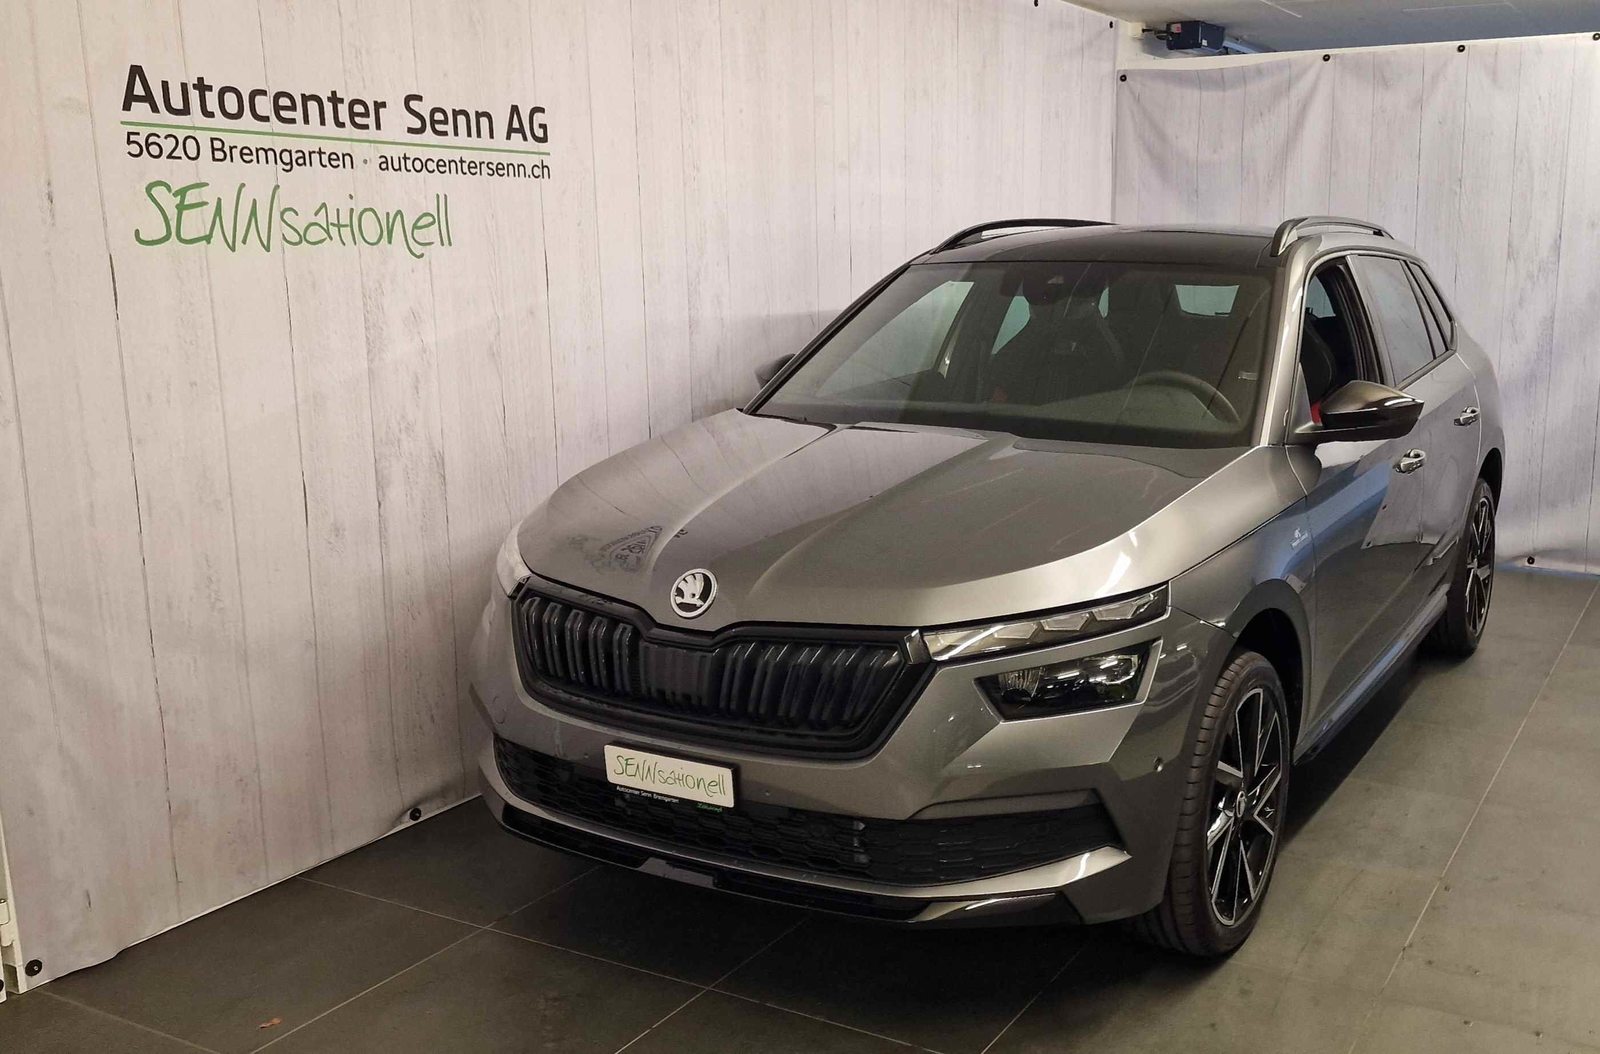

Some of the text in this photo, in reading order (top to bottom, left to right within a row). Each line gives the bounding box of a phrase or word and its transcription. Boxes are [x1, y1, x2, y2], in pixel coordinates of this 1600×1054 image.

[121, 64, 549, 143] Autocenter Senn AG
[125, 131, 551, 179] 5620 Bremgarten autocentersenn.ch
[134, 180, 453, 258] SENNsationell
[614, 755, 726, 797] SENNsationell
